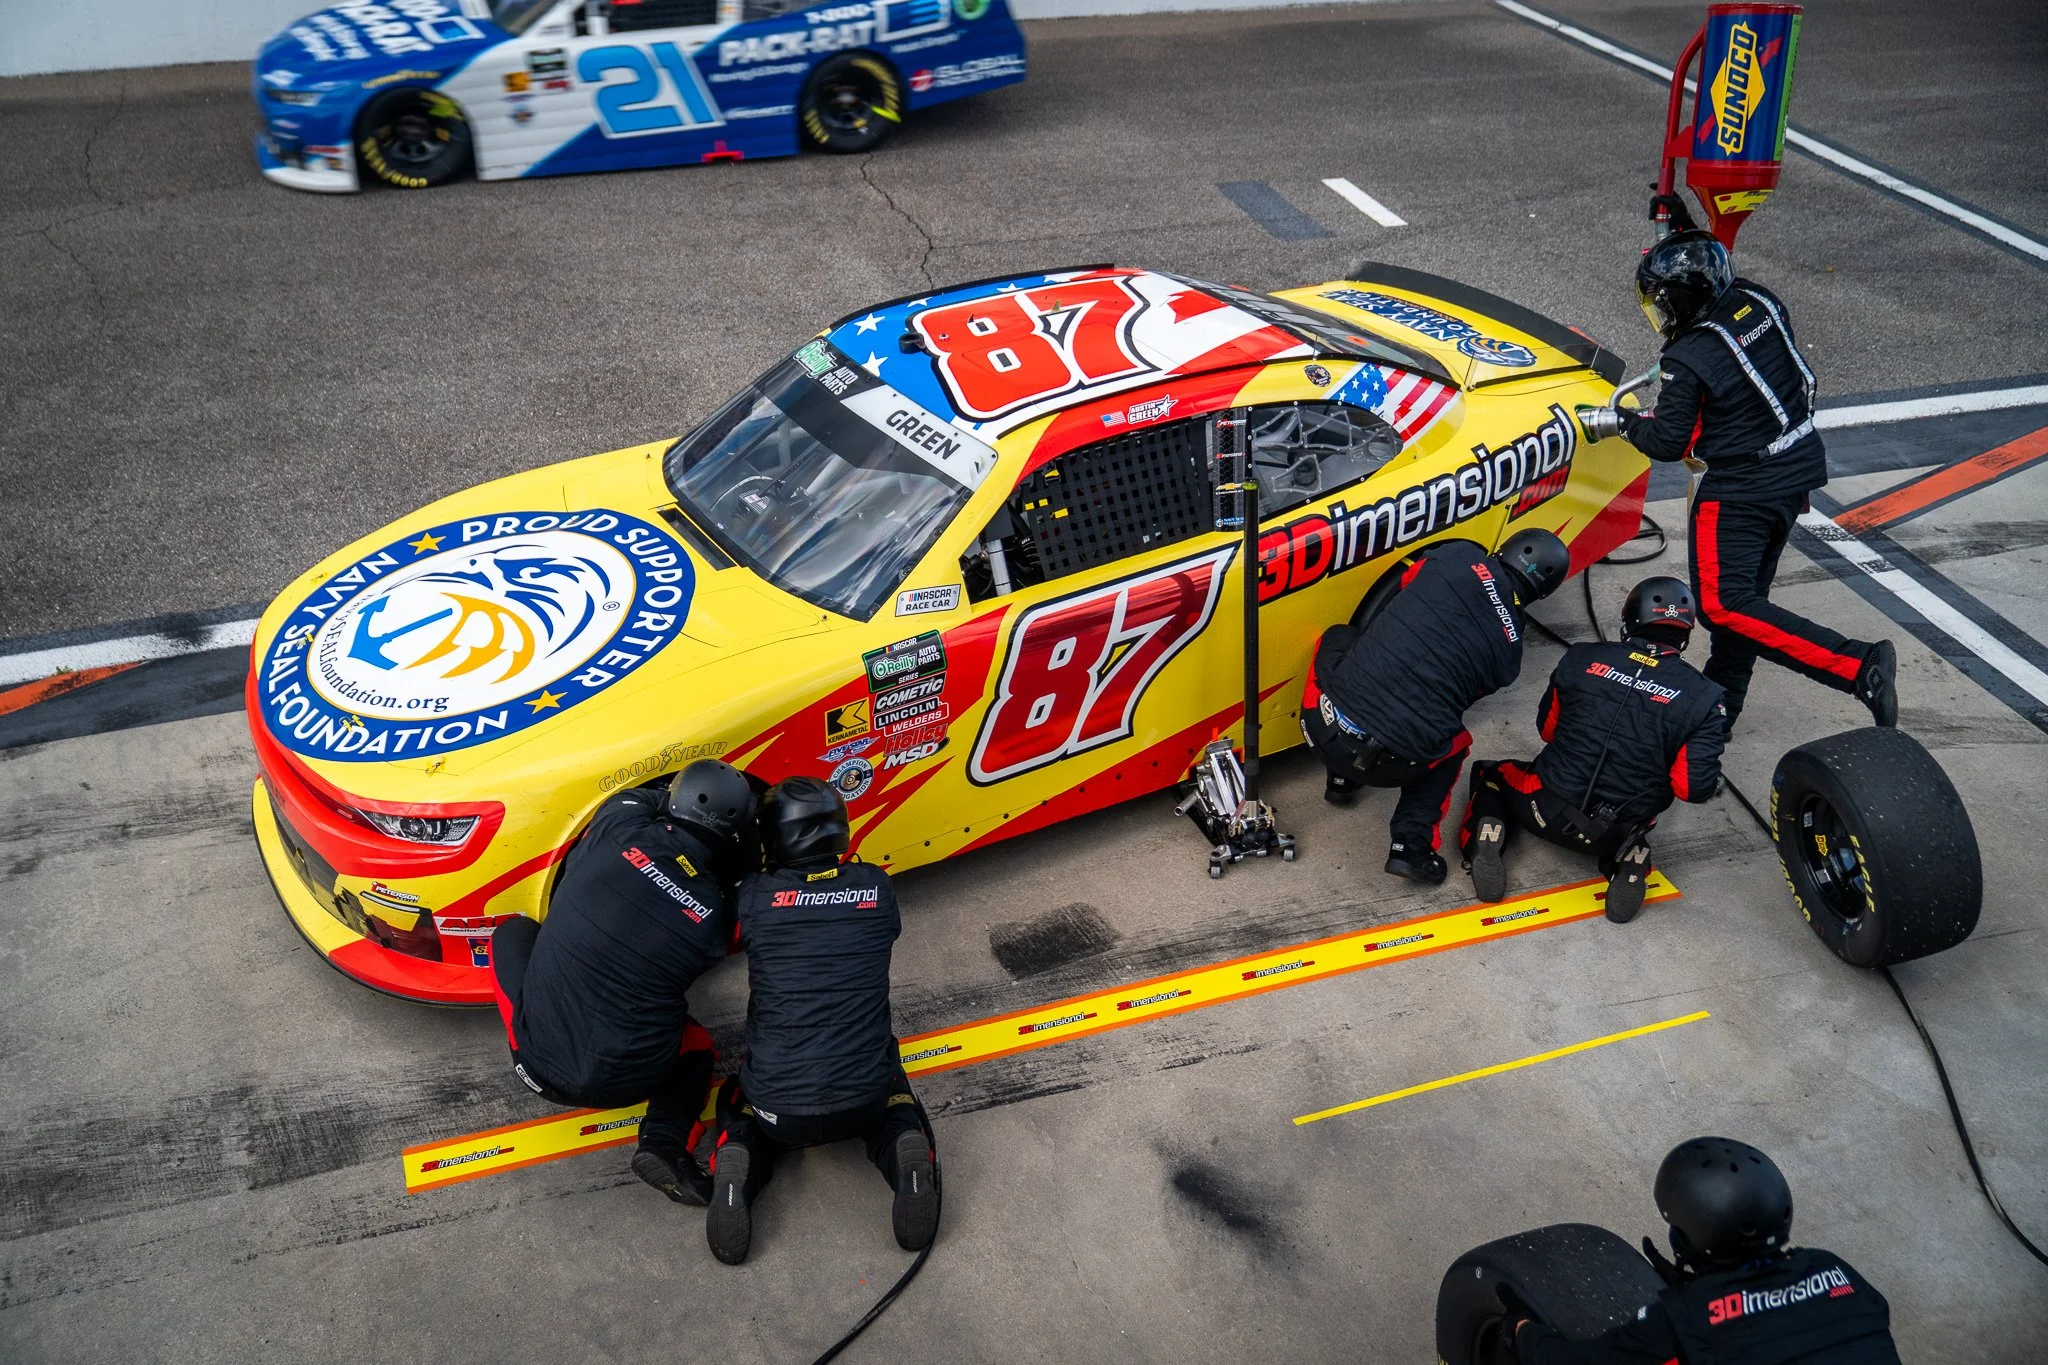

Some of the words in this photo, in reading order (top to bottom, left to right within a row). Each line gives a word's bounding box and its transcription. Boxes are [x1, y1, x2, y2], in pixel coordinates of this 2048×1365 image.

[576, 42, 717, 136] 21
[1720, 28, 1756, 149] SUNOCO
[1340, 289, 1478, 337] FOUNDATION
[1378, 311, 1458, 342] NAVY
[914, 277, 1151, 417] 87
[819, 372, 848, 396] PARTS
[833, 366, 859, 385] AUTO
[1129, 407, 1160, 422] GREEN
[886, 410, 961, 460] GREEN
[1511, 464, 1568, 517] .com
[1258, 407, 1574, 602] 3Dimensional
[302, 552, 398, 620] NAVY
[917, 588, 952, 601] NASCAR
[462, 514, 619, 543] PROUD
[571, 527, 684, 689] SUPPORTER
[905, 601, 930, 611] RACE
[931, 599, 950, 608] CAR
[1470, 562, 1519, 643] 3Dimensional
[893, 637, 917, 651] NASCAR
[267, 624, 316, 694] SEAL
[874, 654, 917, 680] O'Reilly
[918, 644, 937, 658] AUTO
[917, 651, 941, 666] PARTS
[972, 546, 1236, 784] 87
[898, 671, 919, 684] SERIES
[875, 678, 944, 710] COMETIC
[1649, 694, 1671, 705] .com
[270, 681, 509, 756] FOUNDATION
[878, 700, 936, 727] LINCOLN
[892, 710, 942, 733] WELDERS
[827, 725, 869, 744] KENNAMETAL
[884, 723, 949, 757] Holley
[598, 741, 728, 793] GOODYEAR
[883, 742, 940, 771] MSD
[832, 759, 869, 780] CHAMPION
[621, 847, 713, 919] 3Dimensional
[810, 870, 836, 881] Sabelt
[375, 885, 420, 902] PETERSON
[771, 886, 878, 907] 3Dimensional
[855, 901, 877, 909] .com
[681, 908, 702, 924] .com
[1480, 906, 1538, 926] 3Dimensional
[1363, 933, 1422, 952] 3Dimensional
[1241, 960, 1303, 981] 3Dimensional
[1116, 989, 1180, 1011] 3Dimensional
[1018, 1012, 1085, 1035] 3Dimensional
[420, 1145, 500, 1173] 3Dimensional
[1708, 1265, 1849, 1325] 3Dimensional
[1829, 1284, 1855, 1298] .com
